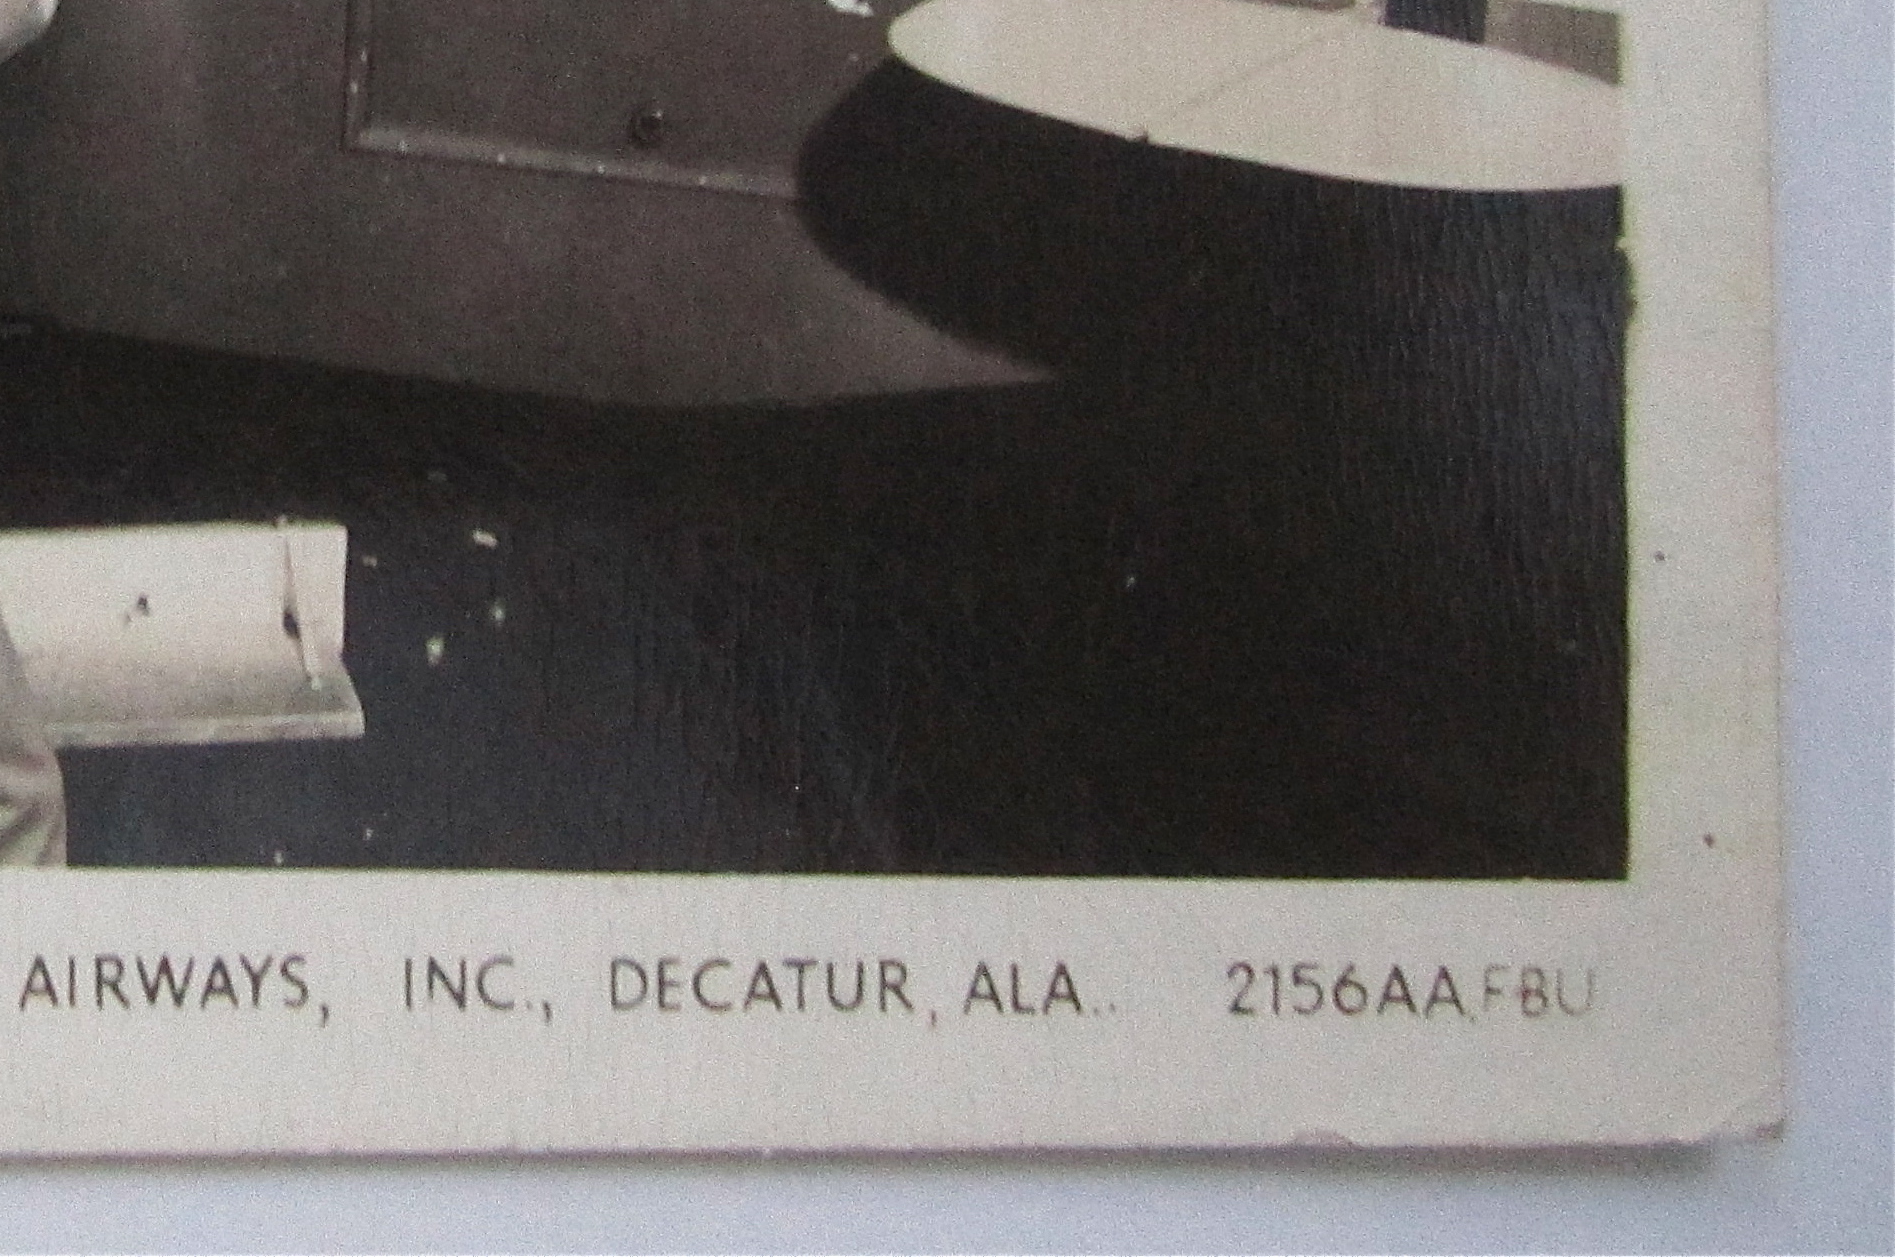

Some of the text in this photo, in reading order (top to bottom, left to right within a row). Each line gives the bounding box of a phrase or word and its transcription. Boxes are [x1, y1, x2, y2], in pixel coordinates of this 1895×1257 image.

[17, 952, 332, 1028] AIRWAYS,
[403, 954, 554, 1026] INC.,
[608, 955, 939, 1029] DECATUR,
